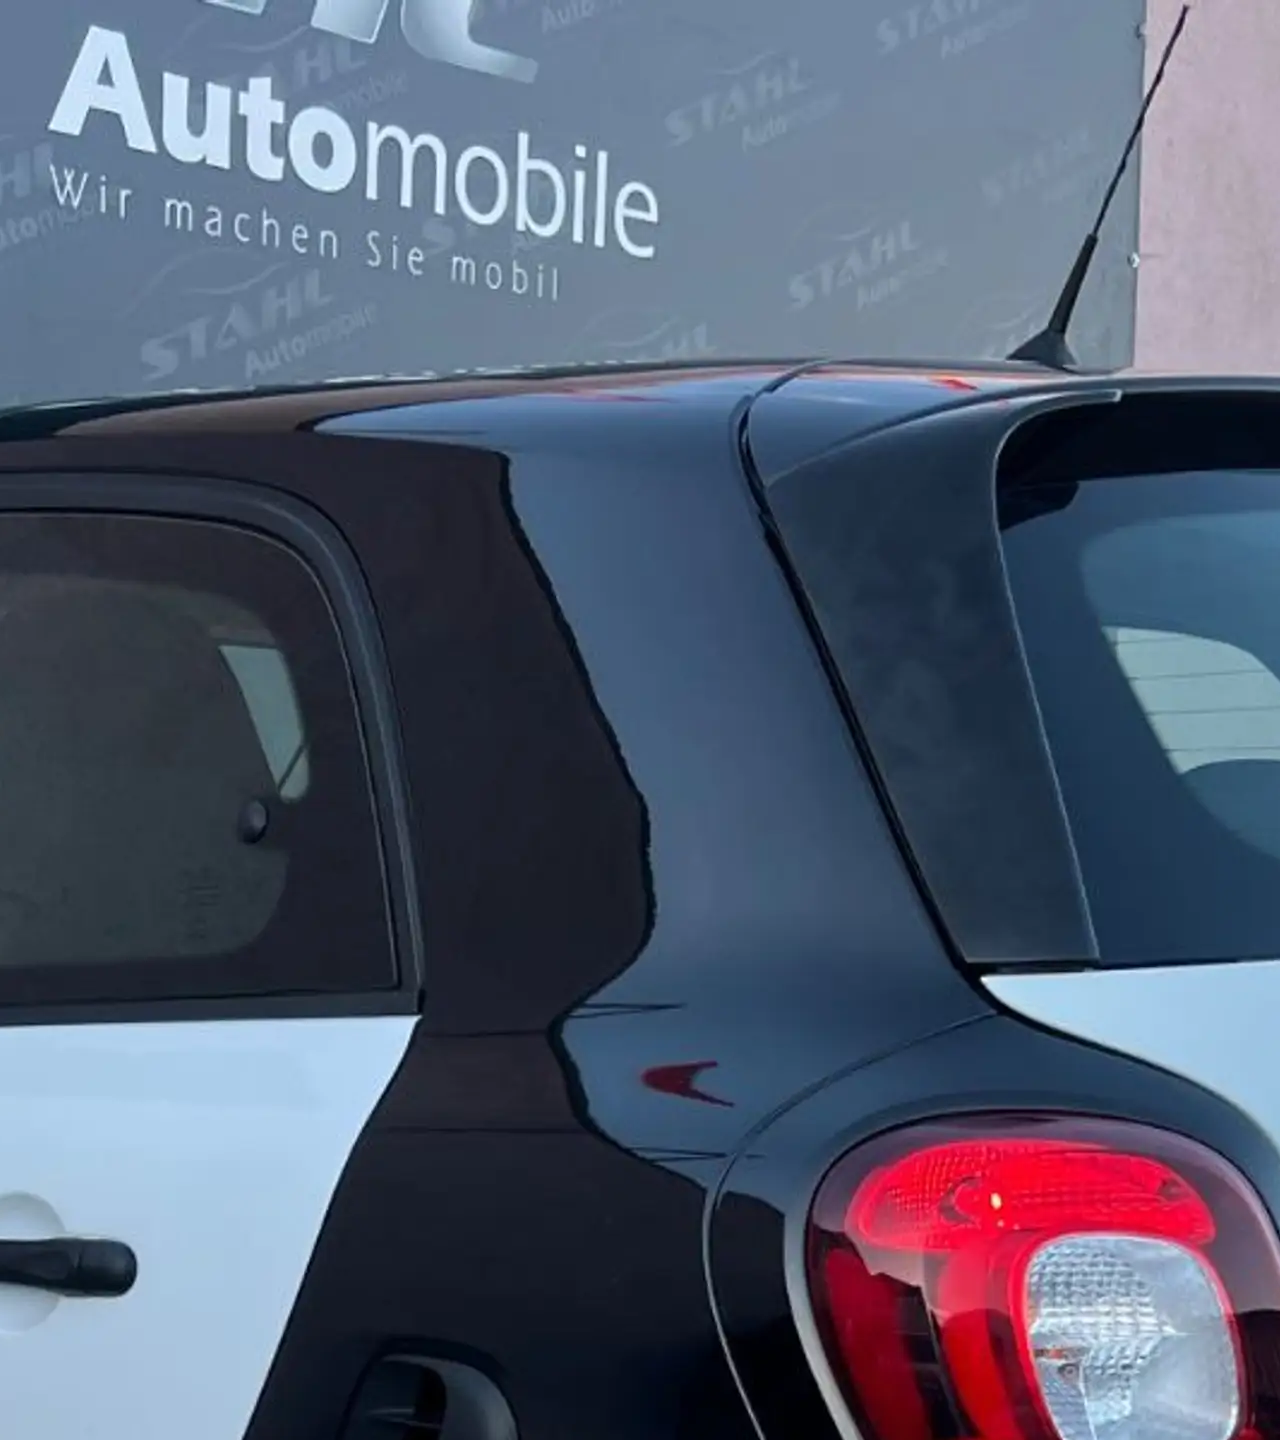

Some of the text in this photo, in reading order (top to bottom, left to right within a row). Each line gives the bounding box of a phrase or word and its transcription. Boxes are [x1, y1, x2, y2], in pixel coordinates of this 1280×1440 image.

[47, 24, 661, 259] Automobile
[663, 56, 818, 152] STAHL
[49, 163, 133, 221] Wir
[163, 193, 339, 261] machen
[367, 230, 426, 278] Sie
[450, 254, 562, 302] mobil
[138, 267, 334, 384] STAHL
